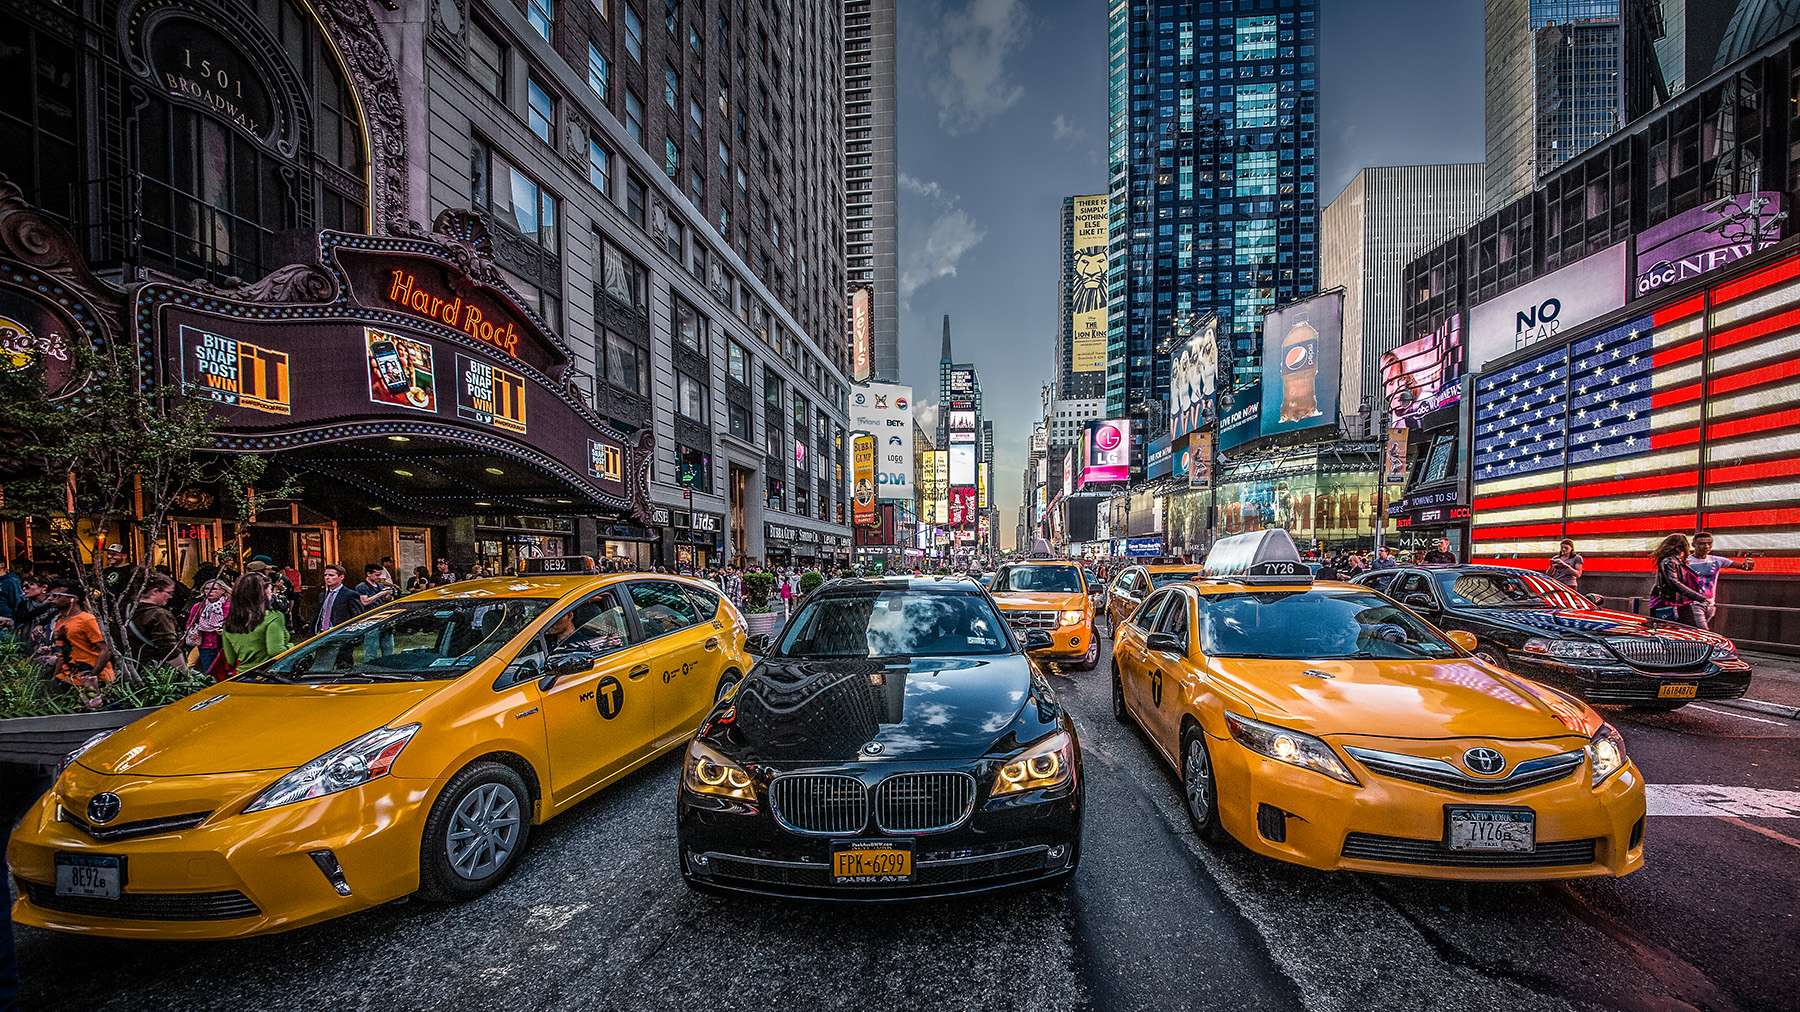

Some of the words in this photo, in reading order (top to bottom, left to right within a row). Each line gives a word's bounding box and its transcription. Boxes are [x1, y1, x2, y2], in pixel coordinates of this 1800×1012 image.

[185, 49, 243, 99] 1501
[166, 73, 258, 131] BROADWAY
[1075, 213, 1108, 221] NOTHING
[1638, 269, 1676, 292] abc
[391, 270, 461, 326] Hard
[464, 305, 518, 358] Rock
[1515, 298, 1561, 334] NO
[1075, 330, 1090, 340] LION
[1515, 319, 1560, 351] FEAR
[203, 333, 237, 355] BITE
[195, 345, 237, 365] SNAP
[198, 358, 237, 379] POST
[470, 360, 492, 378] BITE
[206, 373, 237, 392] WIN
[465, 371, 491, 388] SNAP
[467, 384, 492, 401] POST
[473, 396, 492, 413] WIN
[886, 419, 901, 427] BET
[1220, 415, 1231, 428] LIVE
[1231, 410, 1243, 423] FOR
[1243, 402, 1259, 418] NOW
[854, 442, 873, 452] BUBBA
[855, 453, 872, 463] GUMP
[887, 454, 904, 462] LOGO
[1097, 451, 1118, 465] LG
[1434, 493, 1445, 503] TO
[692, 513, 714, 530] Lids
[1421, 510, 1441, 521] ESPN
[1400, 538, 1428, 547] MAY
[544, 559, 566, 571] 8E92
[1264, 563, 1295, 575] 7Y26
[579, 691, 595, 702] NYC
[600, 682, 617, 715] T
[1470, 813, 1488, 821] NEW
[1491, 813, 1512, 822] YORK
[840, 853, 863, 874] FPK
[873, 852, 904, 873] 6299
[837, 875, 877, 883] PARK
